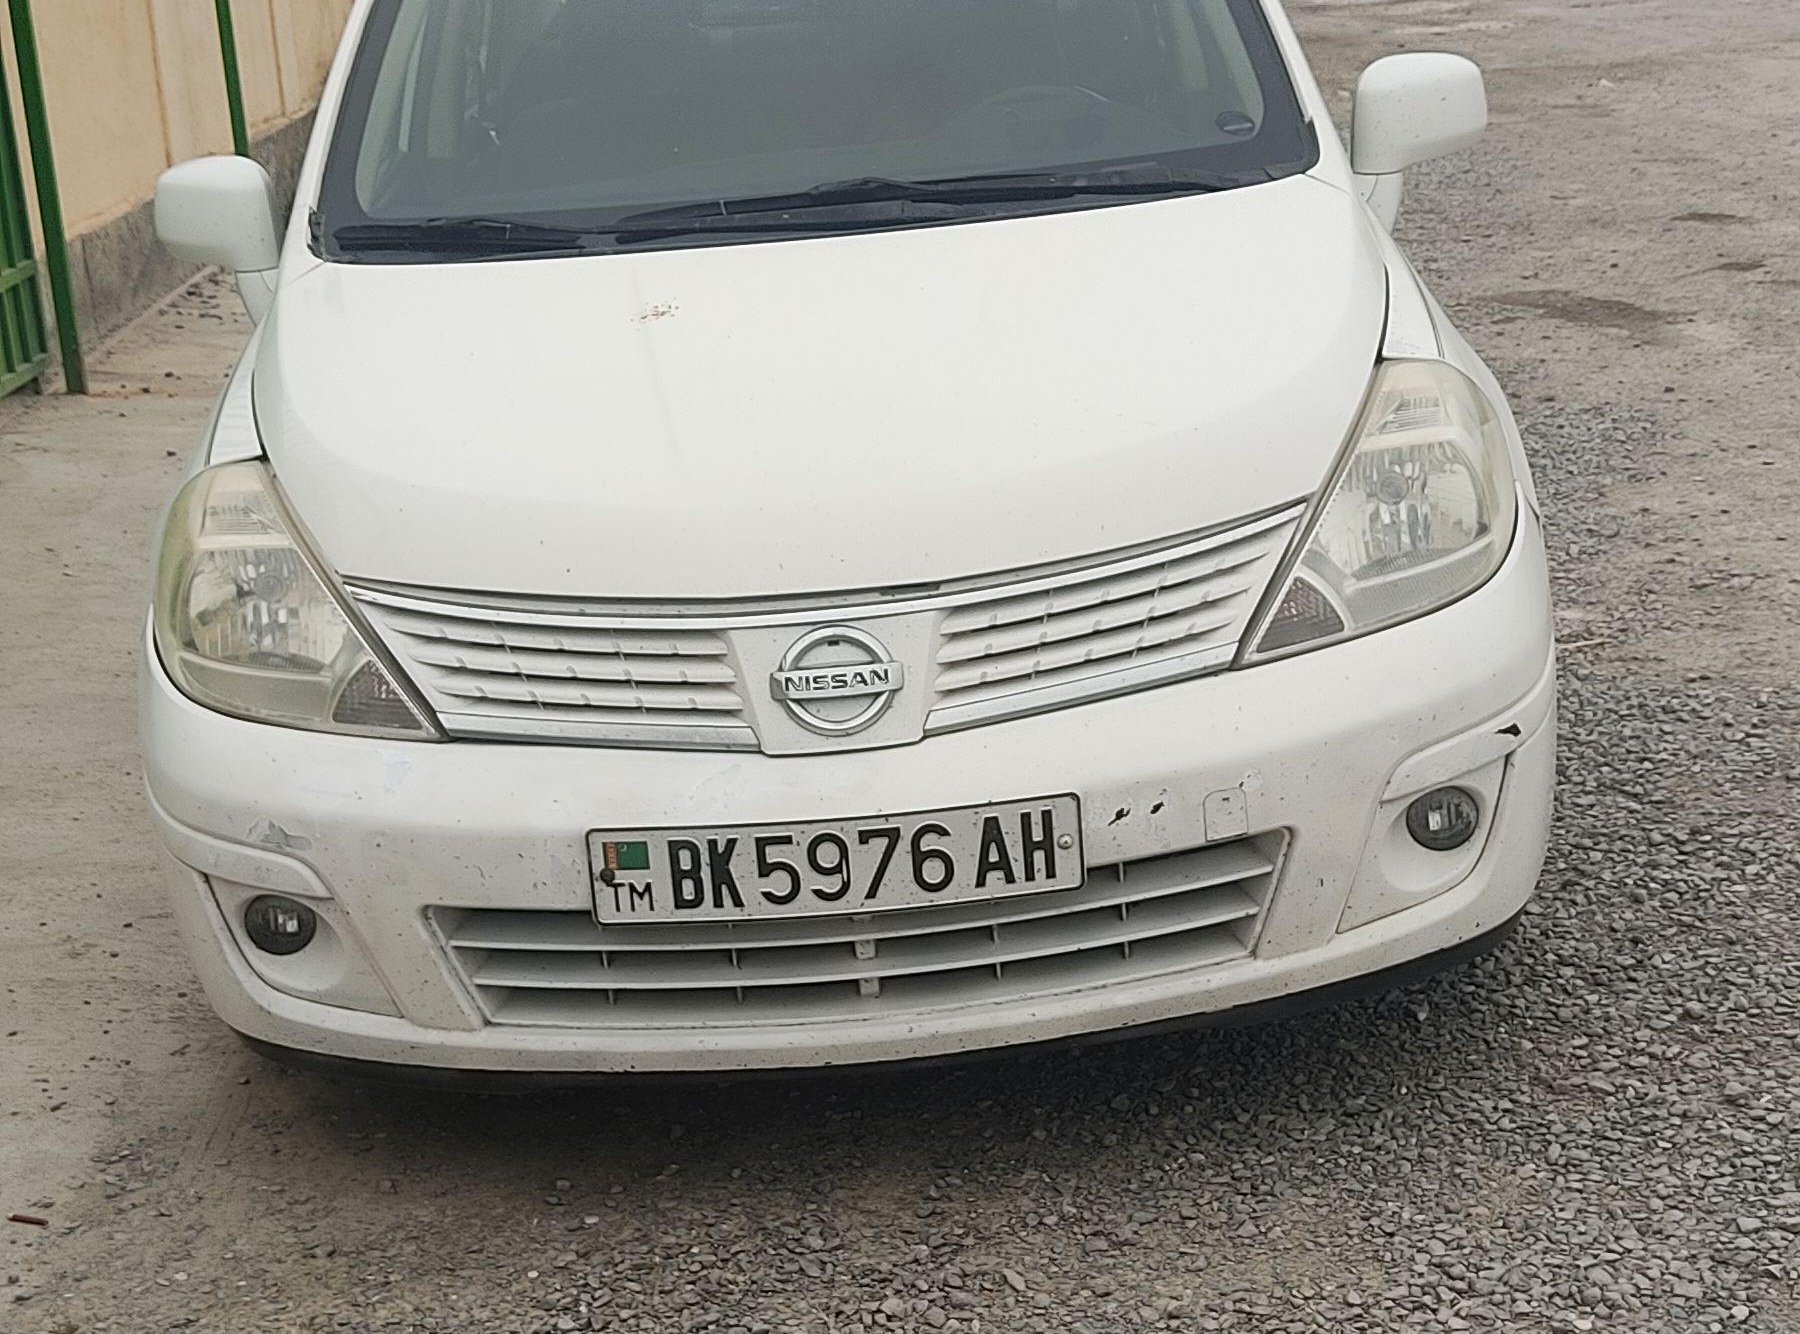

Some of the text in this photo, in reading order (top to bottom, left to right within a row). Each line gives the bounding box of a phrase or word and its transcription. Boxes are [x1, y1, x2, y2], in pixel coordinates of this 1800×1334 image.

[784, 668, 889, 692] NISSAN
[975, 808, 1058, 888] AH
[612, 881, 655, 913] TM
